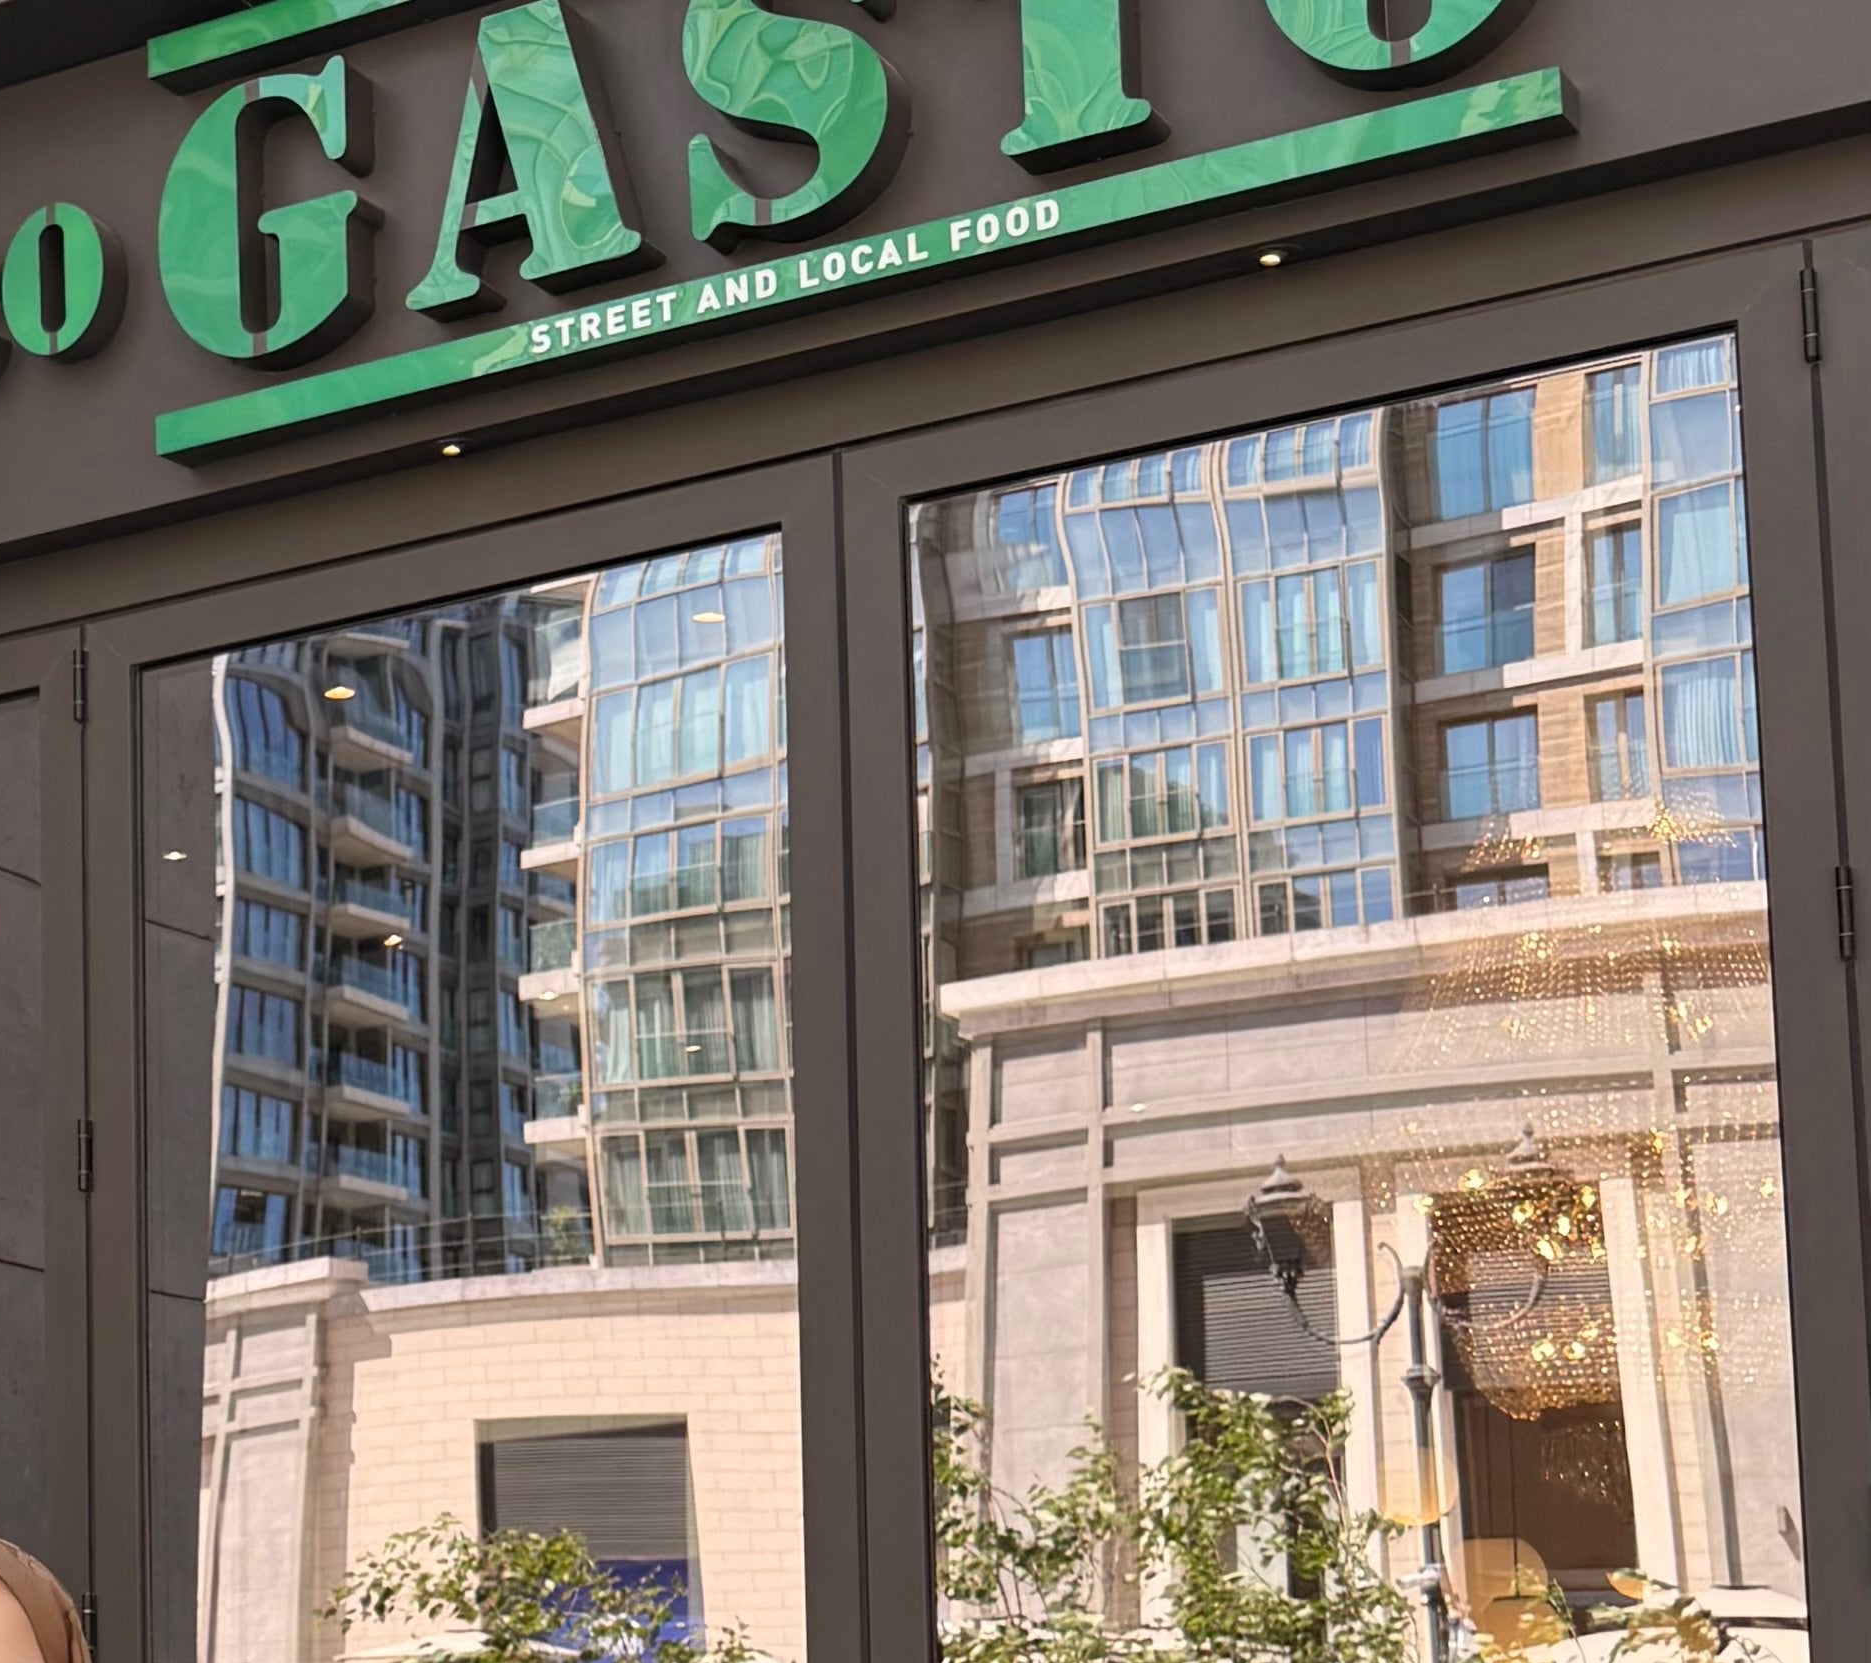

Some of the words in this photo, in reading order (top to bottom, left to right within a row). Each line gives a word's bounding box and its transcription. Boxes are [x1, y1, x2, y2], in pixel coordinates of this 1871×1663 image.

[158, 0, 1505, 359] GAS
[531, 292, 677, 354] STREET
[697, 269, 777, 314] AND
[798, 233, 929, 289] LOCAL
[950, 199, 1060, 252] FOOD
